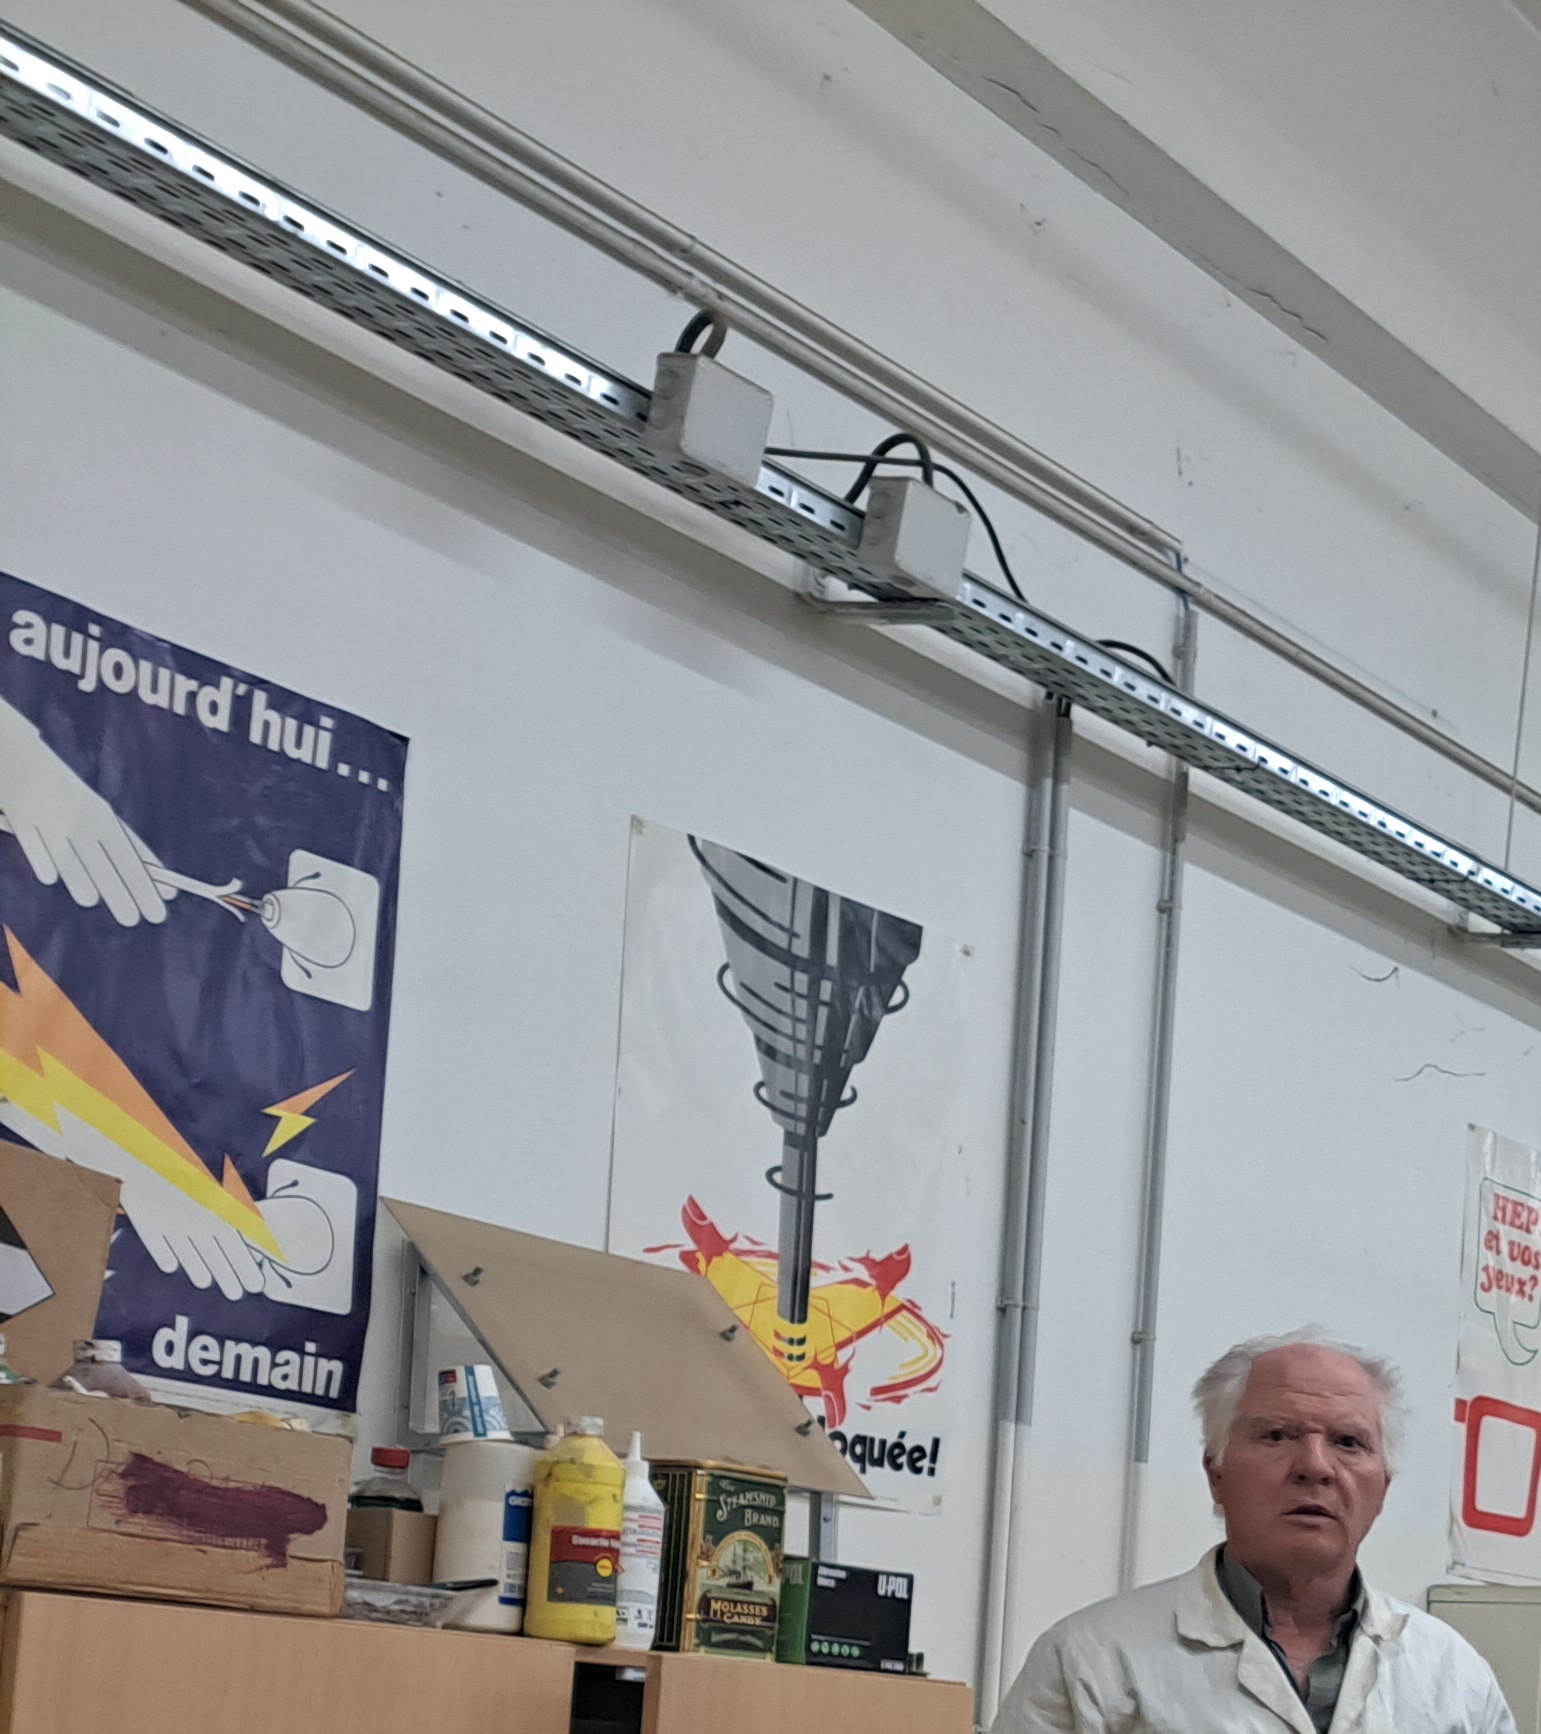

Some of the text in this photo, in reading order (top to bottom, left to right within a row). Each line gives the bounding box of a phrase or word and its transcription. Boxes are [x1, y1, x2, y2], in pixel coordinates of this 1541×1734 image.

[1483, 1229, 1505, 1258] et
[151, 1314, 345, 1399] demain
[710, 1599, 768, 1617] MOLASSES
